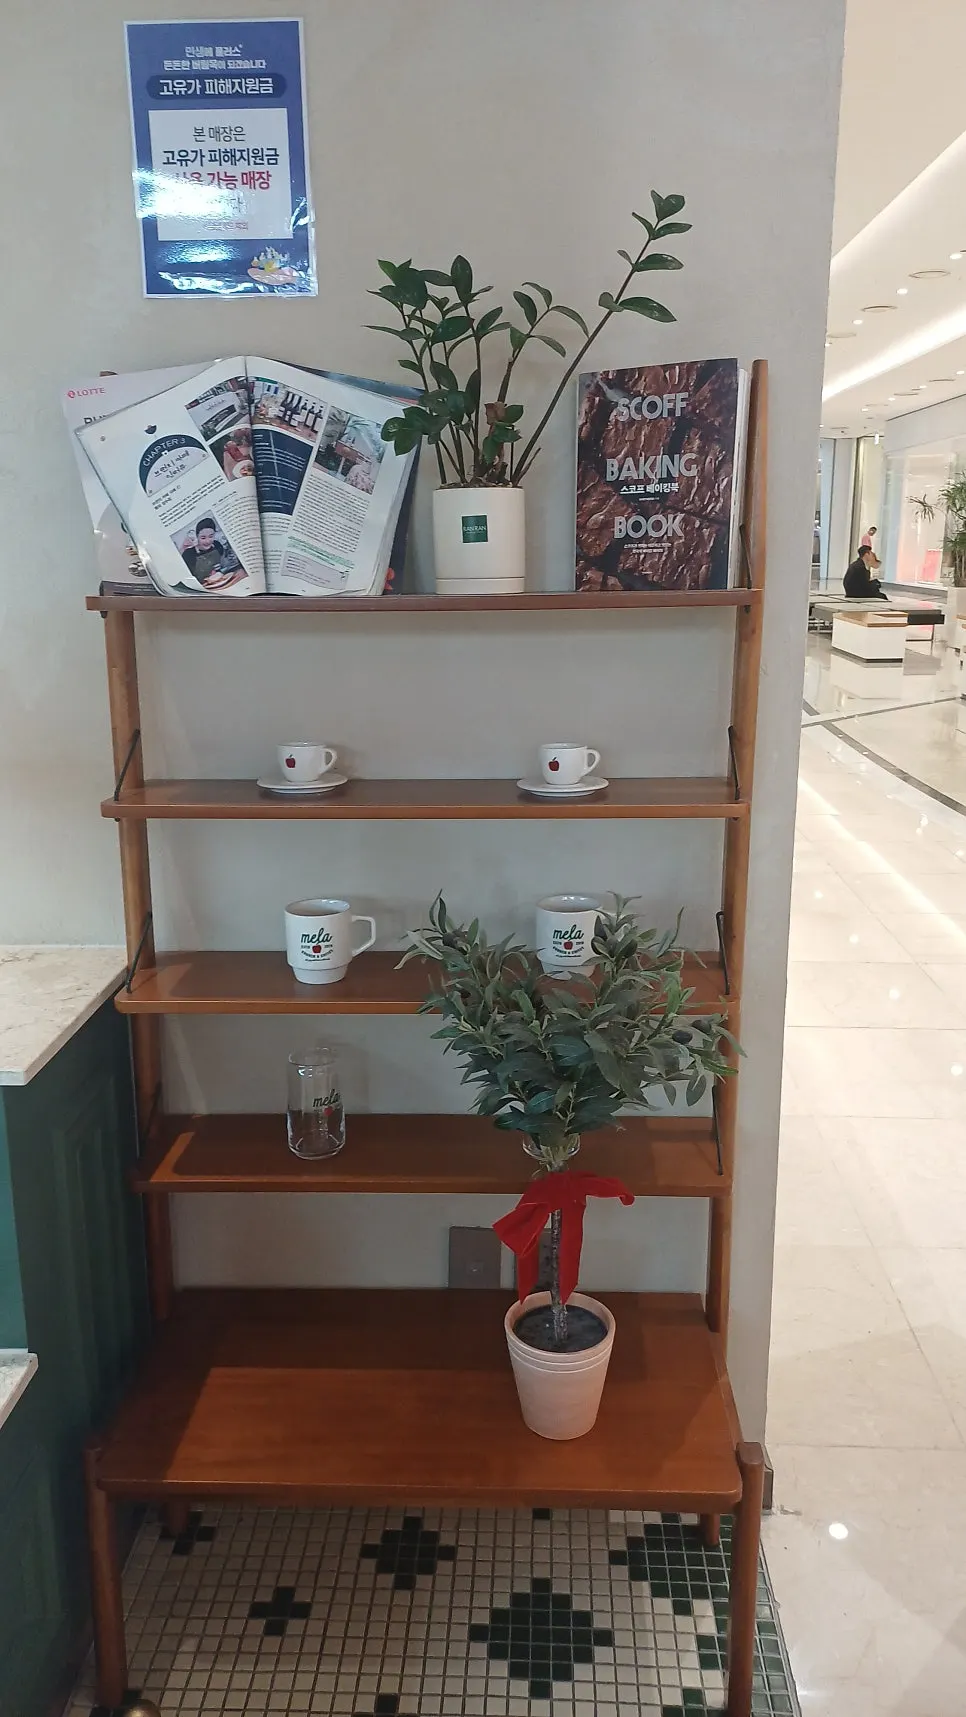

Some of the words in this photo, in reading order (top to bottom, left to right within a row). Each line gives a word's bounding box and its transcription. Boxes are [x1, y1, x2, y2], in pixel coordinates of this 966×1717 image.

[164, 60, 190, 70] 든든한
[159, 79, 202, 95] 고유가
[204, 78, 274, 95] 피해지원금
[193, 126, 206, 143] 본
[208, 125, 246, 143] 매장은
[162, 148, 205, 167] 고유가
[208, 147, 279, 166] 피해지원금
[207, 171, 238, 190] 가능
[241, 170, 272, 190] 매장
[77, 387, 106, 397] LOTTE
[616, 391, 689, 422] SCOFF
[142, 438, 179, 467] CHAPTER
[605, 452, 698, 482] BAKING
[620, 484, 645, 495] 스코프
[646, 482, 680, 493] 베이킹북
[613, 512, 685, 539] BOOK
[300, 927, 333, 945] mela
[552, 924, 584, 940] mela
[312, 1088, 342, 1108] mela
